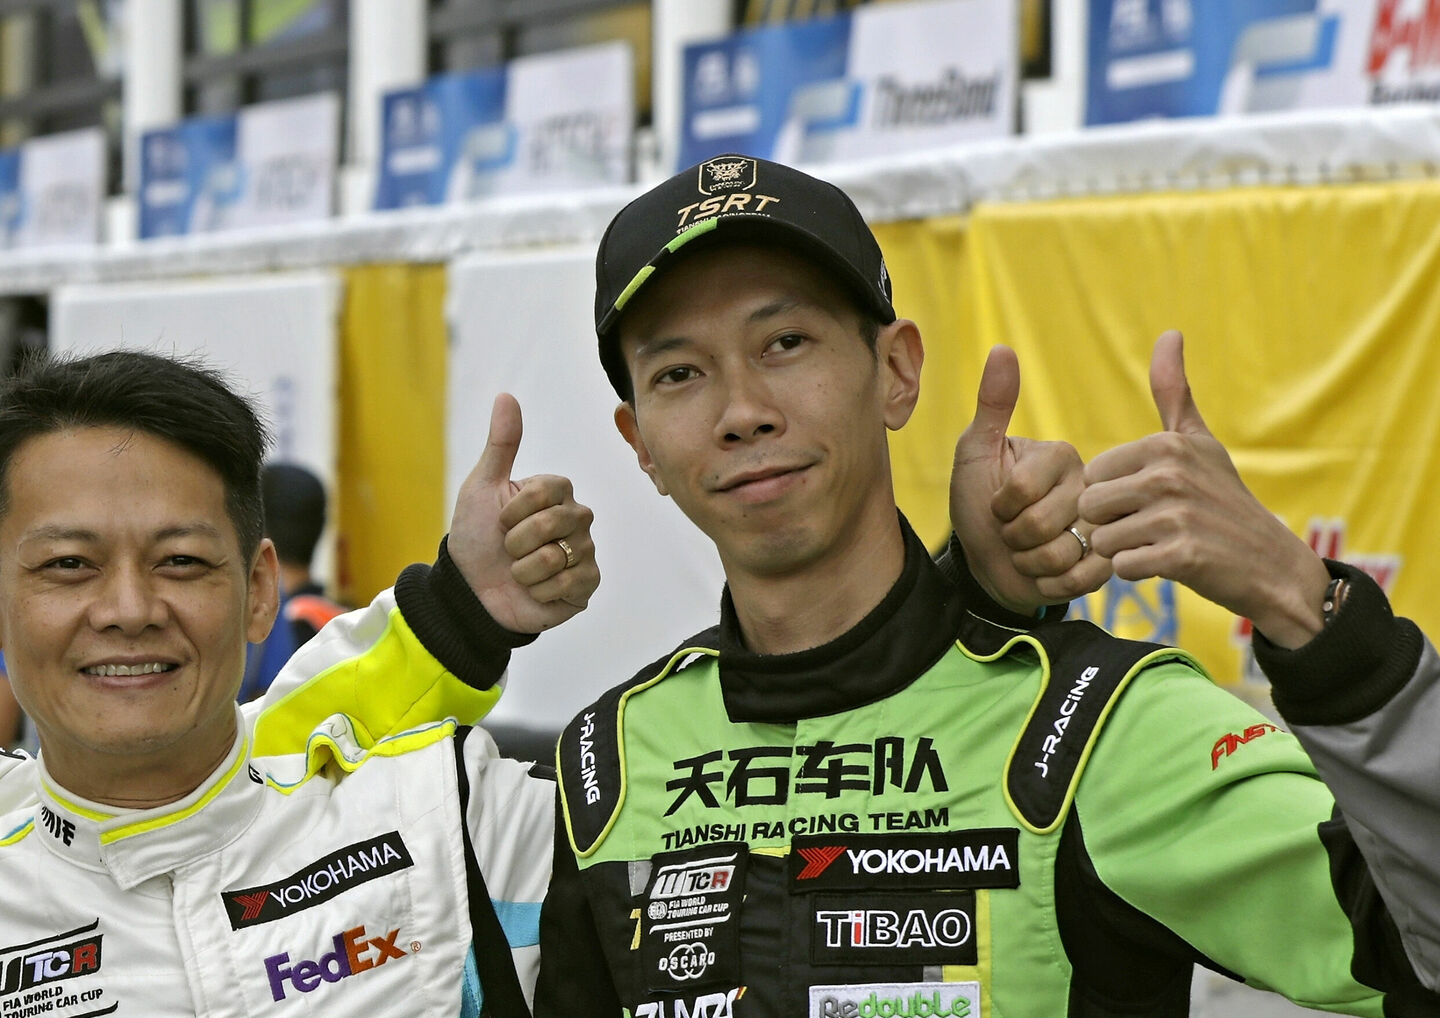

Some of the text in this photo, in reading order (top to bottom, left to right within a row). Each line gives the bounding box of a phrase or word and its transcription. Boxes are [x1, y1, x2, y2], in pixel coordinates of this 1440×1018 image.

[677, 193, 781, 227] TSRT
[663, 736, 949, 817] 天石车队
[661, 807, 950, 850] TIANSHI RACING TEAM
[846, 844, 1011, 874] YOKOHAMA
[270, 842, 401, 909] YOKOHAMA
[667, 903, 729, 919] TOURING CAR CUP
[668, 897, 706, 909] FIA WORLD
[664, 927, 714, 943] PRESENTED BY
[264, 925, 407, 1002] FedEx
[659, 952, 715, 971] OSCARO
[3, 986, 63, 1011] FIA WORLD
[56, 995, 78, 1008] CAR
[81, 988, 103, 1001] CUP
